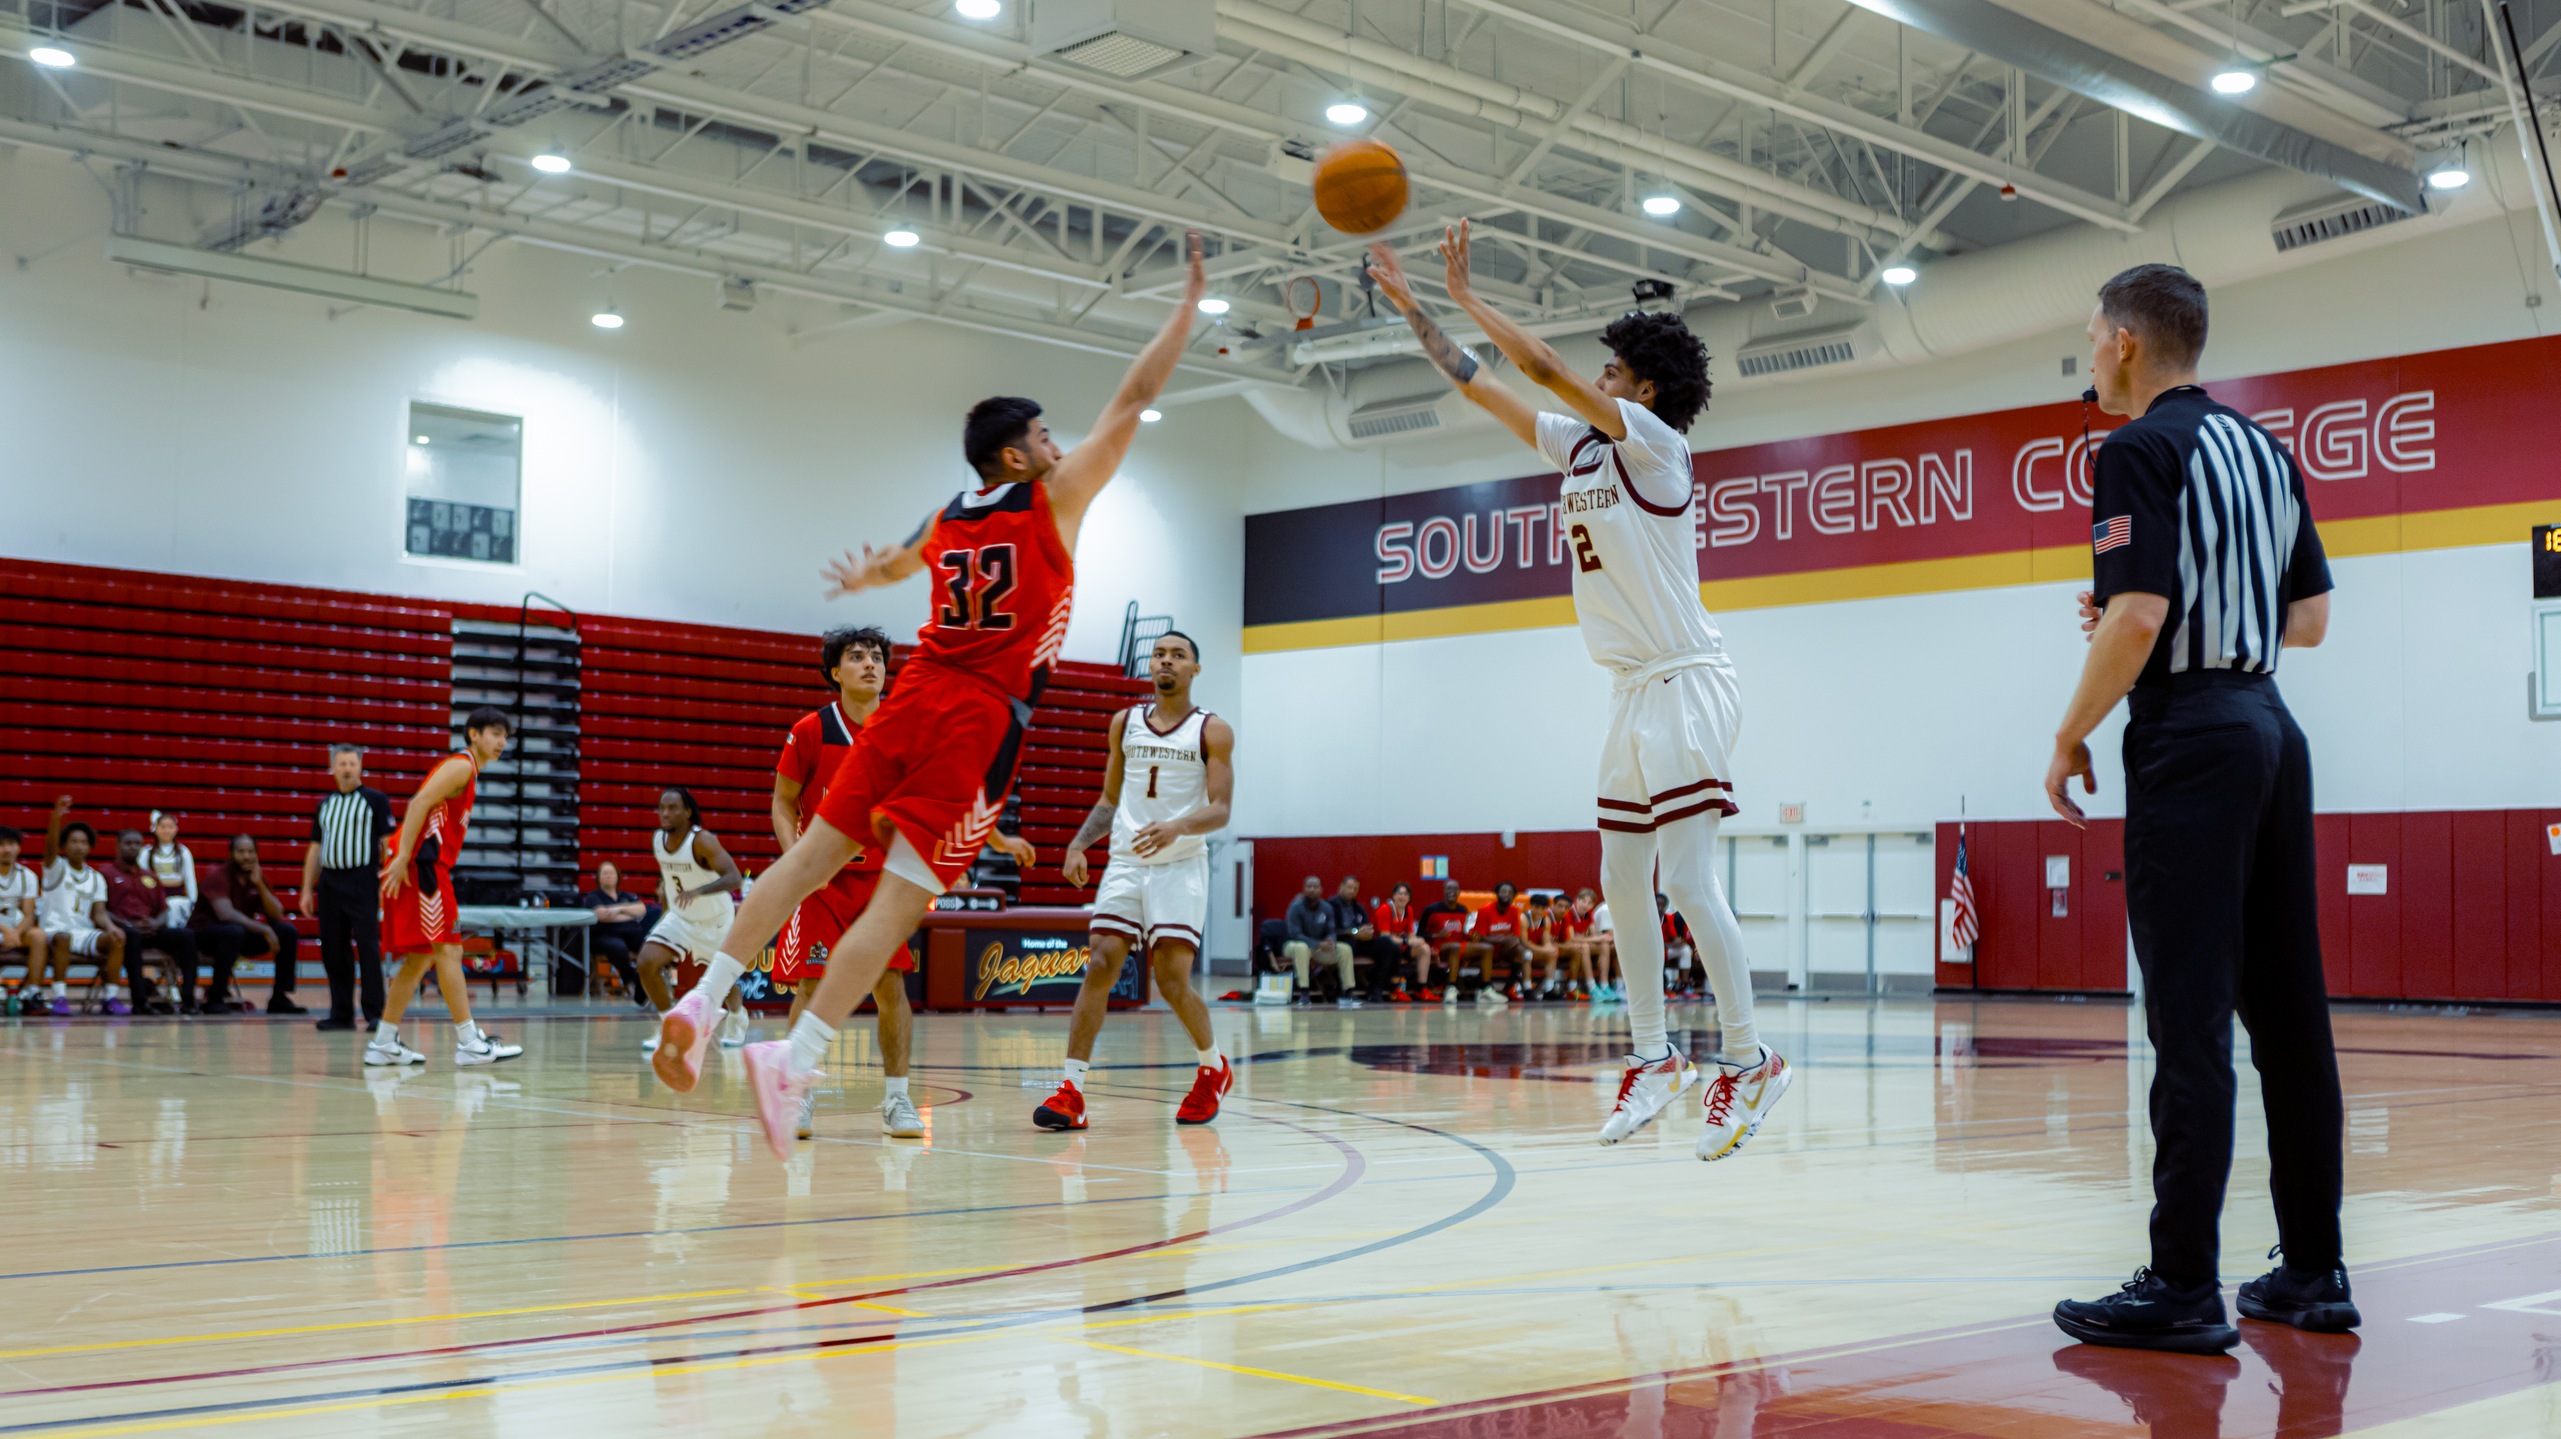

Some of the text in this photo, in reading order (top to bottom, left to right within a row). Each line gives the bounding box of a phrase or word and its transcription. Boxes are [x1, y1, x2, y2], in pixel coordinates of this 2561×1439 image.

[1571, 523, 1604, 575] 2
[938, 543, 1018, 631] 32
[1146, 764, 1160, 800] 1
[671, 875, 684, 894] 3
[1022, 937, 1068, 949] Home of the
